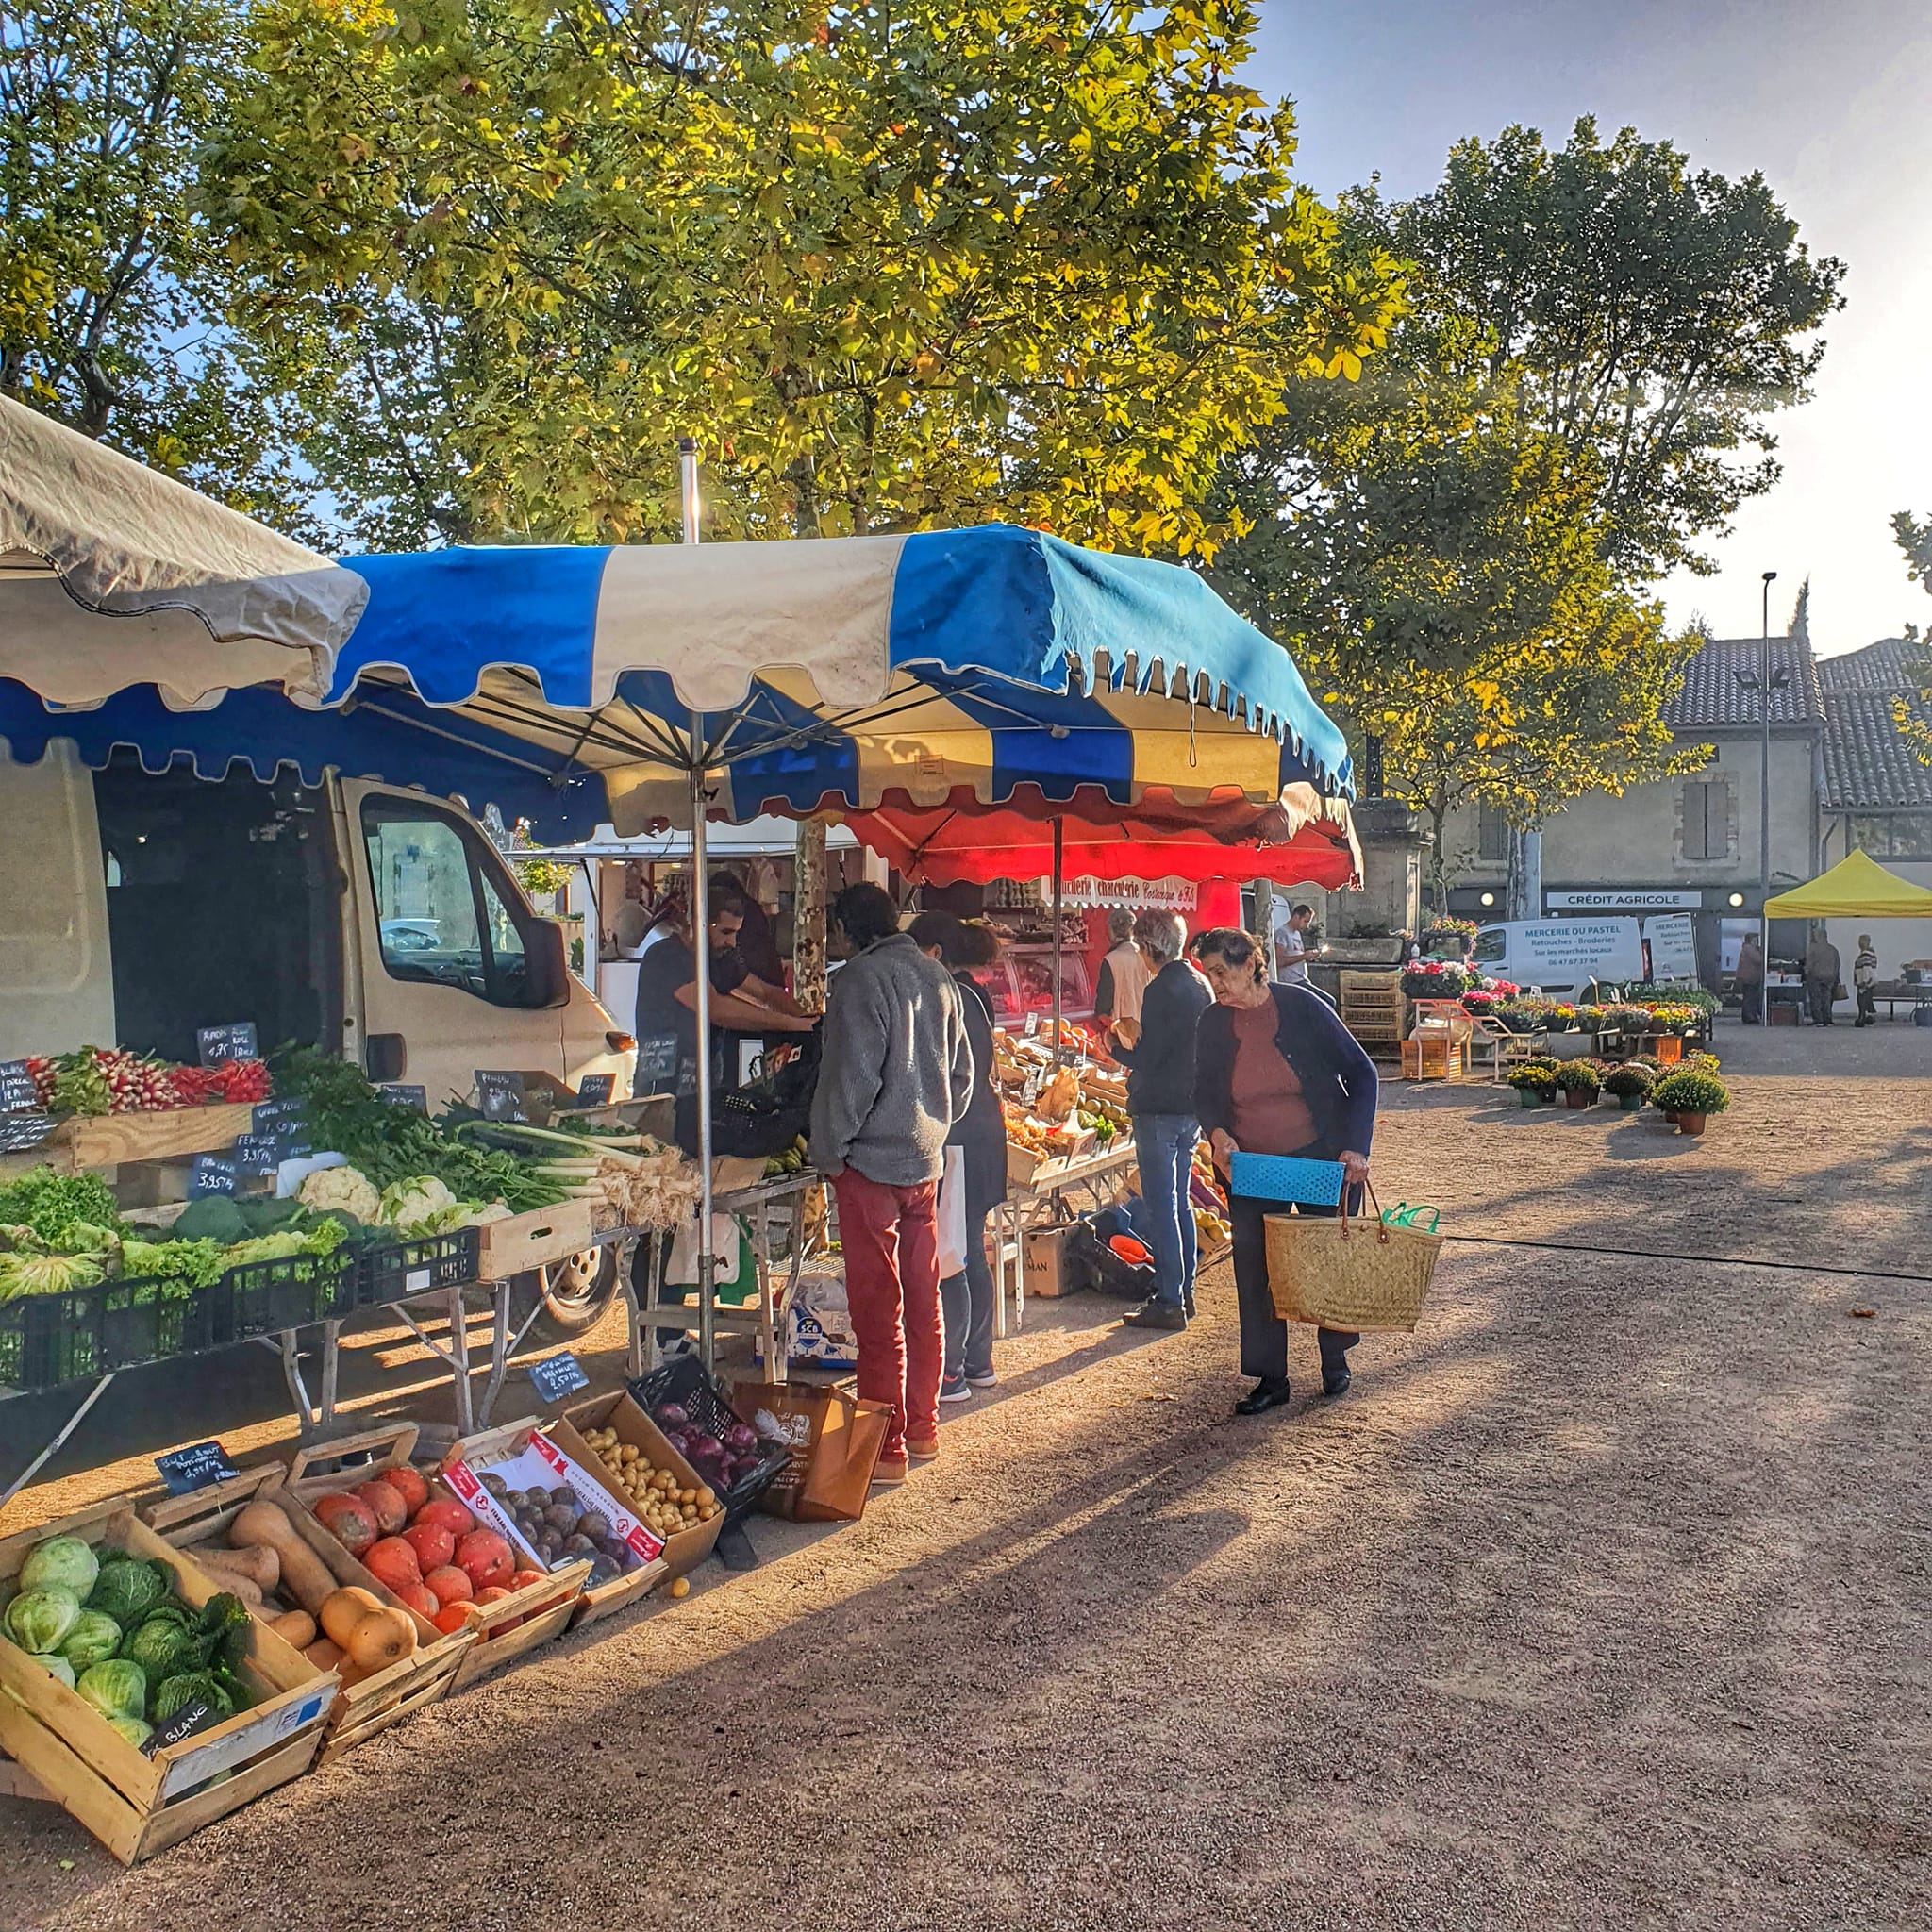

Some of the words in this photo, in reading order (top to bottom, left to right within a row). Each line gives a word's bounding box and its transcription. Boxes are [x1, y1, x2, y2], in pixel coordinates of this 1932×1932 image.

[1050, 876, 1091, 895] ucherie
[1568, 894, 1612, 904] CRÉDIT
[1615, 895, 1680, 904] AGRICOLE
[1524, 927, 1570, 938] MERCERIE
[1572, 927, 1586, 936] DU
[1587, 925, 1621, 934] PASTEL
[801, 1324, 818, 1333] SCB
[165, 1706, 208, 1742] BLANC
